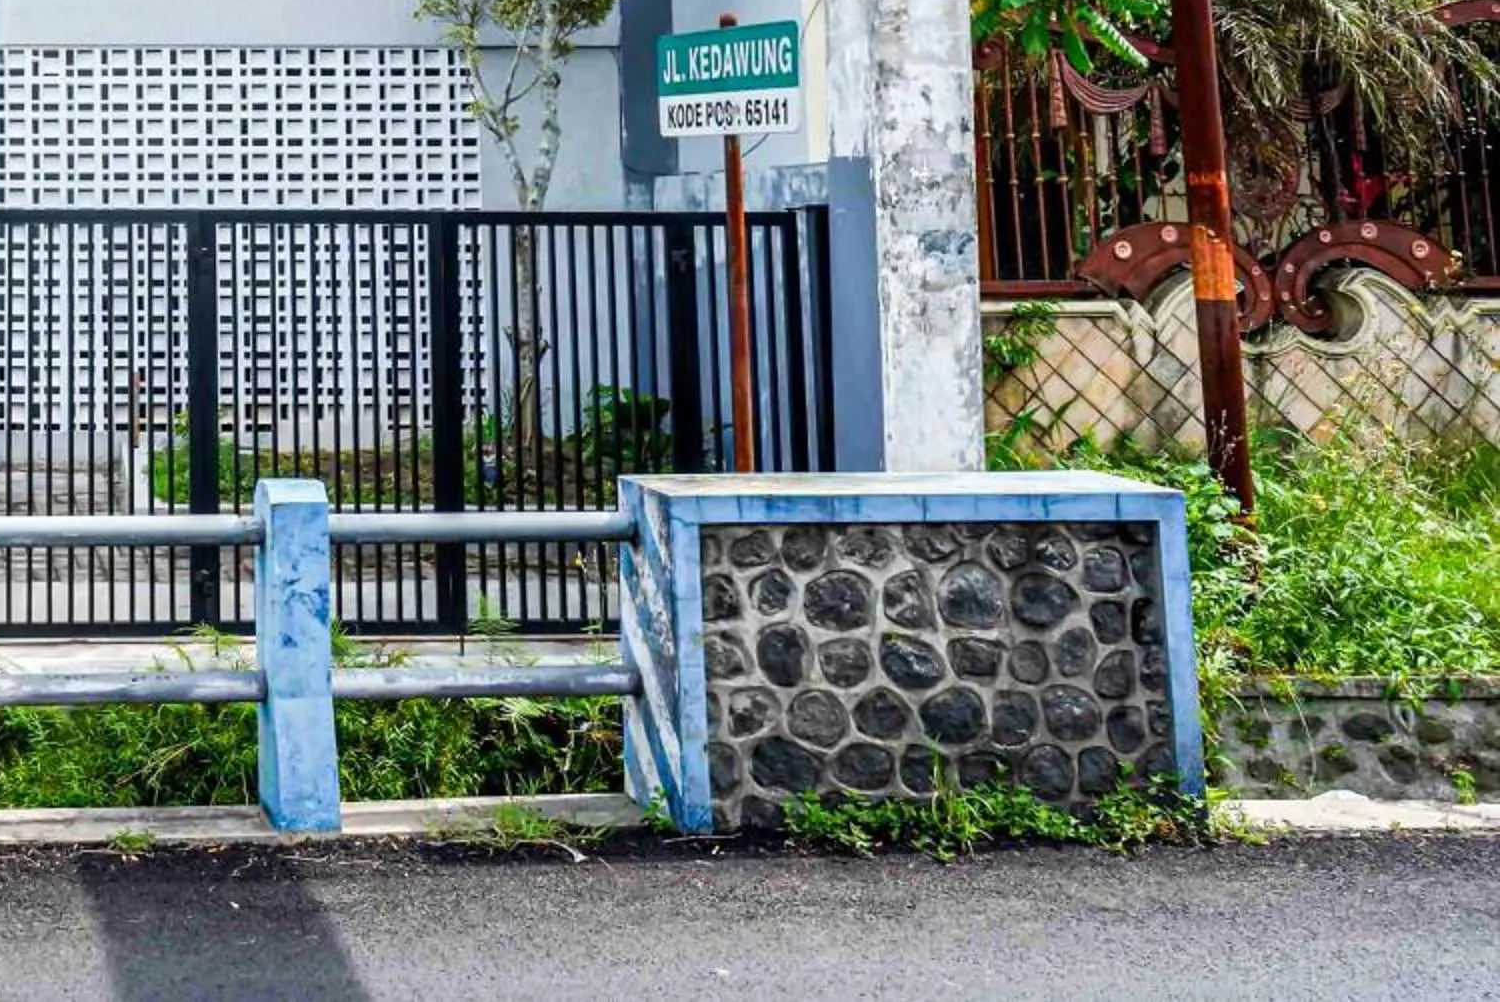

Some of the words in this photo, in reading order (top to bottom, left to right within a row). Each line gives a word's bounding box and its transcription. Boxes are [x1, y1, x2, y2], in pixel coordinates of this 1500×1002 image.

[663, 50, 686, 84] JL.
[689, 36, 793, 81] KEDAWUNG
[667, 101, 702, 129] KODE
[745, 97, 789, 127] 65141
